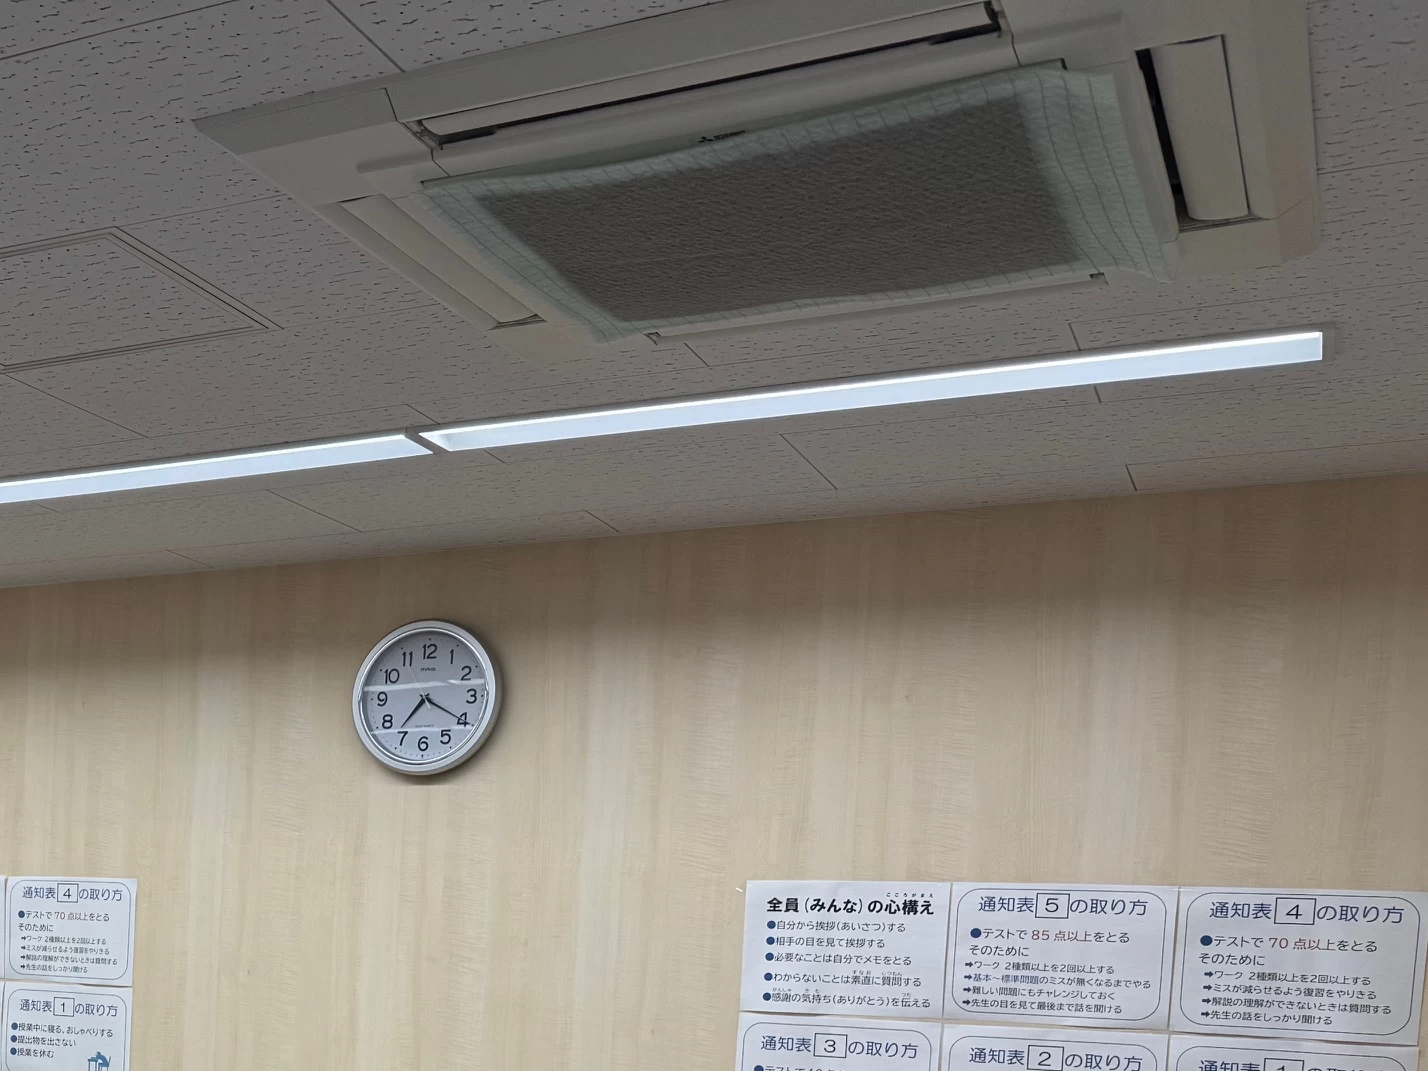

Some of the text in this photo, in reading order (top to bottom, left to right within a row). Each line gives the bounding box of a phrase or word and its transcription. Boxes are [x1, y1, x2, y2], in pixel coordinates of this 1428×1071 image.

[402, 651, 413, 667] 11
[422, 644, 438, 660] 12
[450, 649, 454, 664] 1
[385, 669, 400, 684] 10
[461, 666, 472, 681] 2
[377, 692, 388, 707] 9
[466, 689, 477, 704] 3
[382, 714, 393, 729] 8
[457, 712, 469, 727] 4
[398, 731, 408, 746] 7
[418, 737, 429, 751] 6
[440, 730, 452, 744] 5
[55, 912, 65, 920] 70
[18, 923, 53, 932] そのために
[776, 936, 885, 948] 相手の目を見て挨拶する
[983, 929, 1130, 943] テストで 85 点以上をとる
[969, 945, 1029, 957] そのために
[1213, 936, 1378, 952] テストで 70 点以上をとる
[774, 953, 912, 966] 必要なことは自分でメモをとる
[1198, 953, 1265, 966] そのために
[973, 961, 1115, 974] ワーク 2種類以上を2回以上する
[774, 973, 922, 987] わからないことは素直に質問する
[1214, 971, 1371, 986] ワーク 2種類以上を2回以上する
[972, 986, 1115, 1001] 難しい問題にもチャレンジしておく
[1213, 984, 1377, 1000] ミスが減らせるよう復習をやりきる
[971, 999, 1122, 1014] 先生の目を見て最後まで話を聞ける
[1211, 997, 1392, 1015] 解説の理解ができないときは質問する
[1210, 1010, 1332, 1025] 先生の話をしっかり聞ける
[18, 1035, 77, 1047] 提出物を出さない
[17, 1048, 54, 1058] 授業を休む
